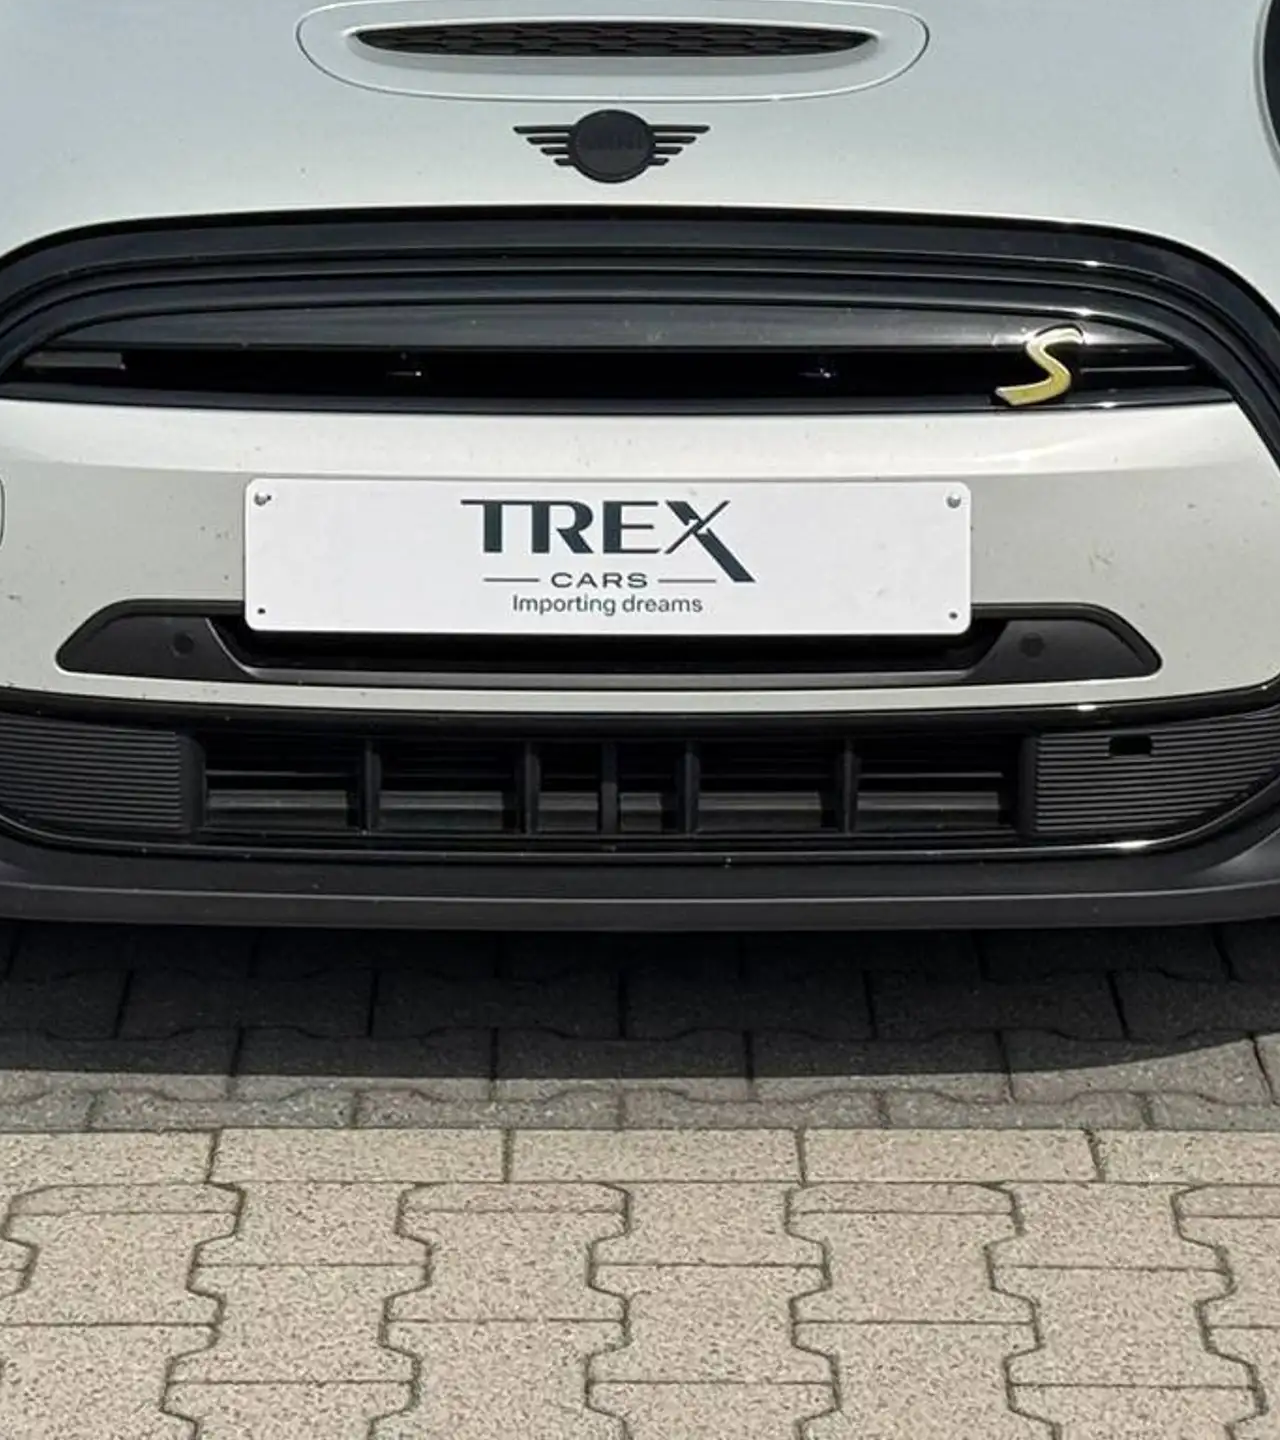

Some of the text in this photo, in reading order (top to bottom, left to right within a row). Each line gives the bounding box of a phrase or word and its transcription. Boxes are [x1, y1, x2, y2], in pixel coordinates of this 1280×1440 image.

[995, 325, 1084, 407] S
[461, 499, 756, 583] TREX
[512, 593, 703, 617] Importing dreams
[551, 572, 648, 588] CARS
